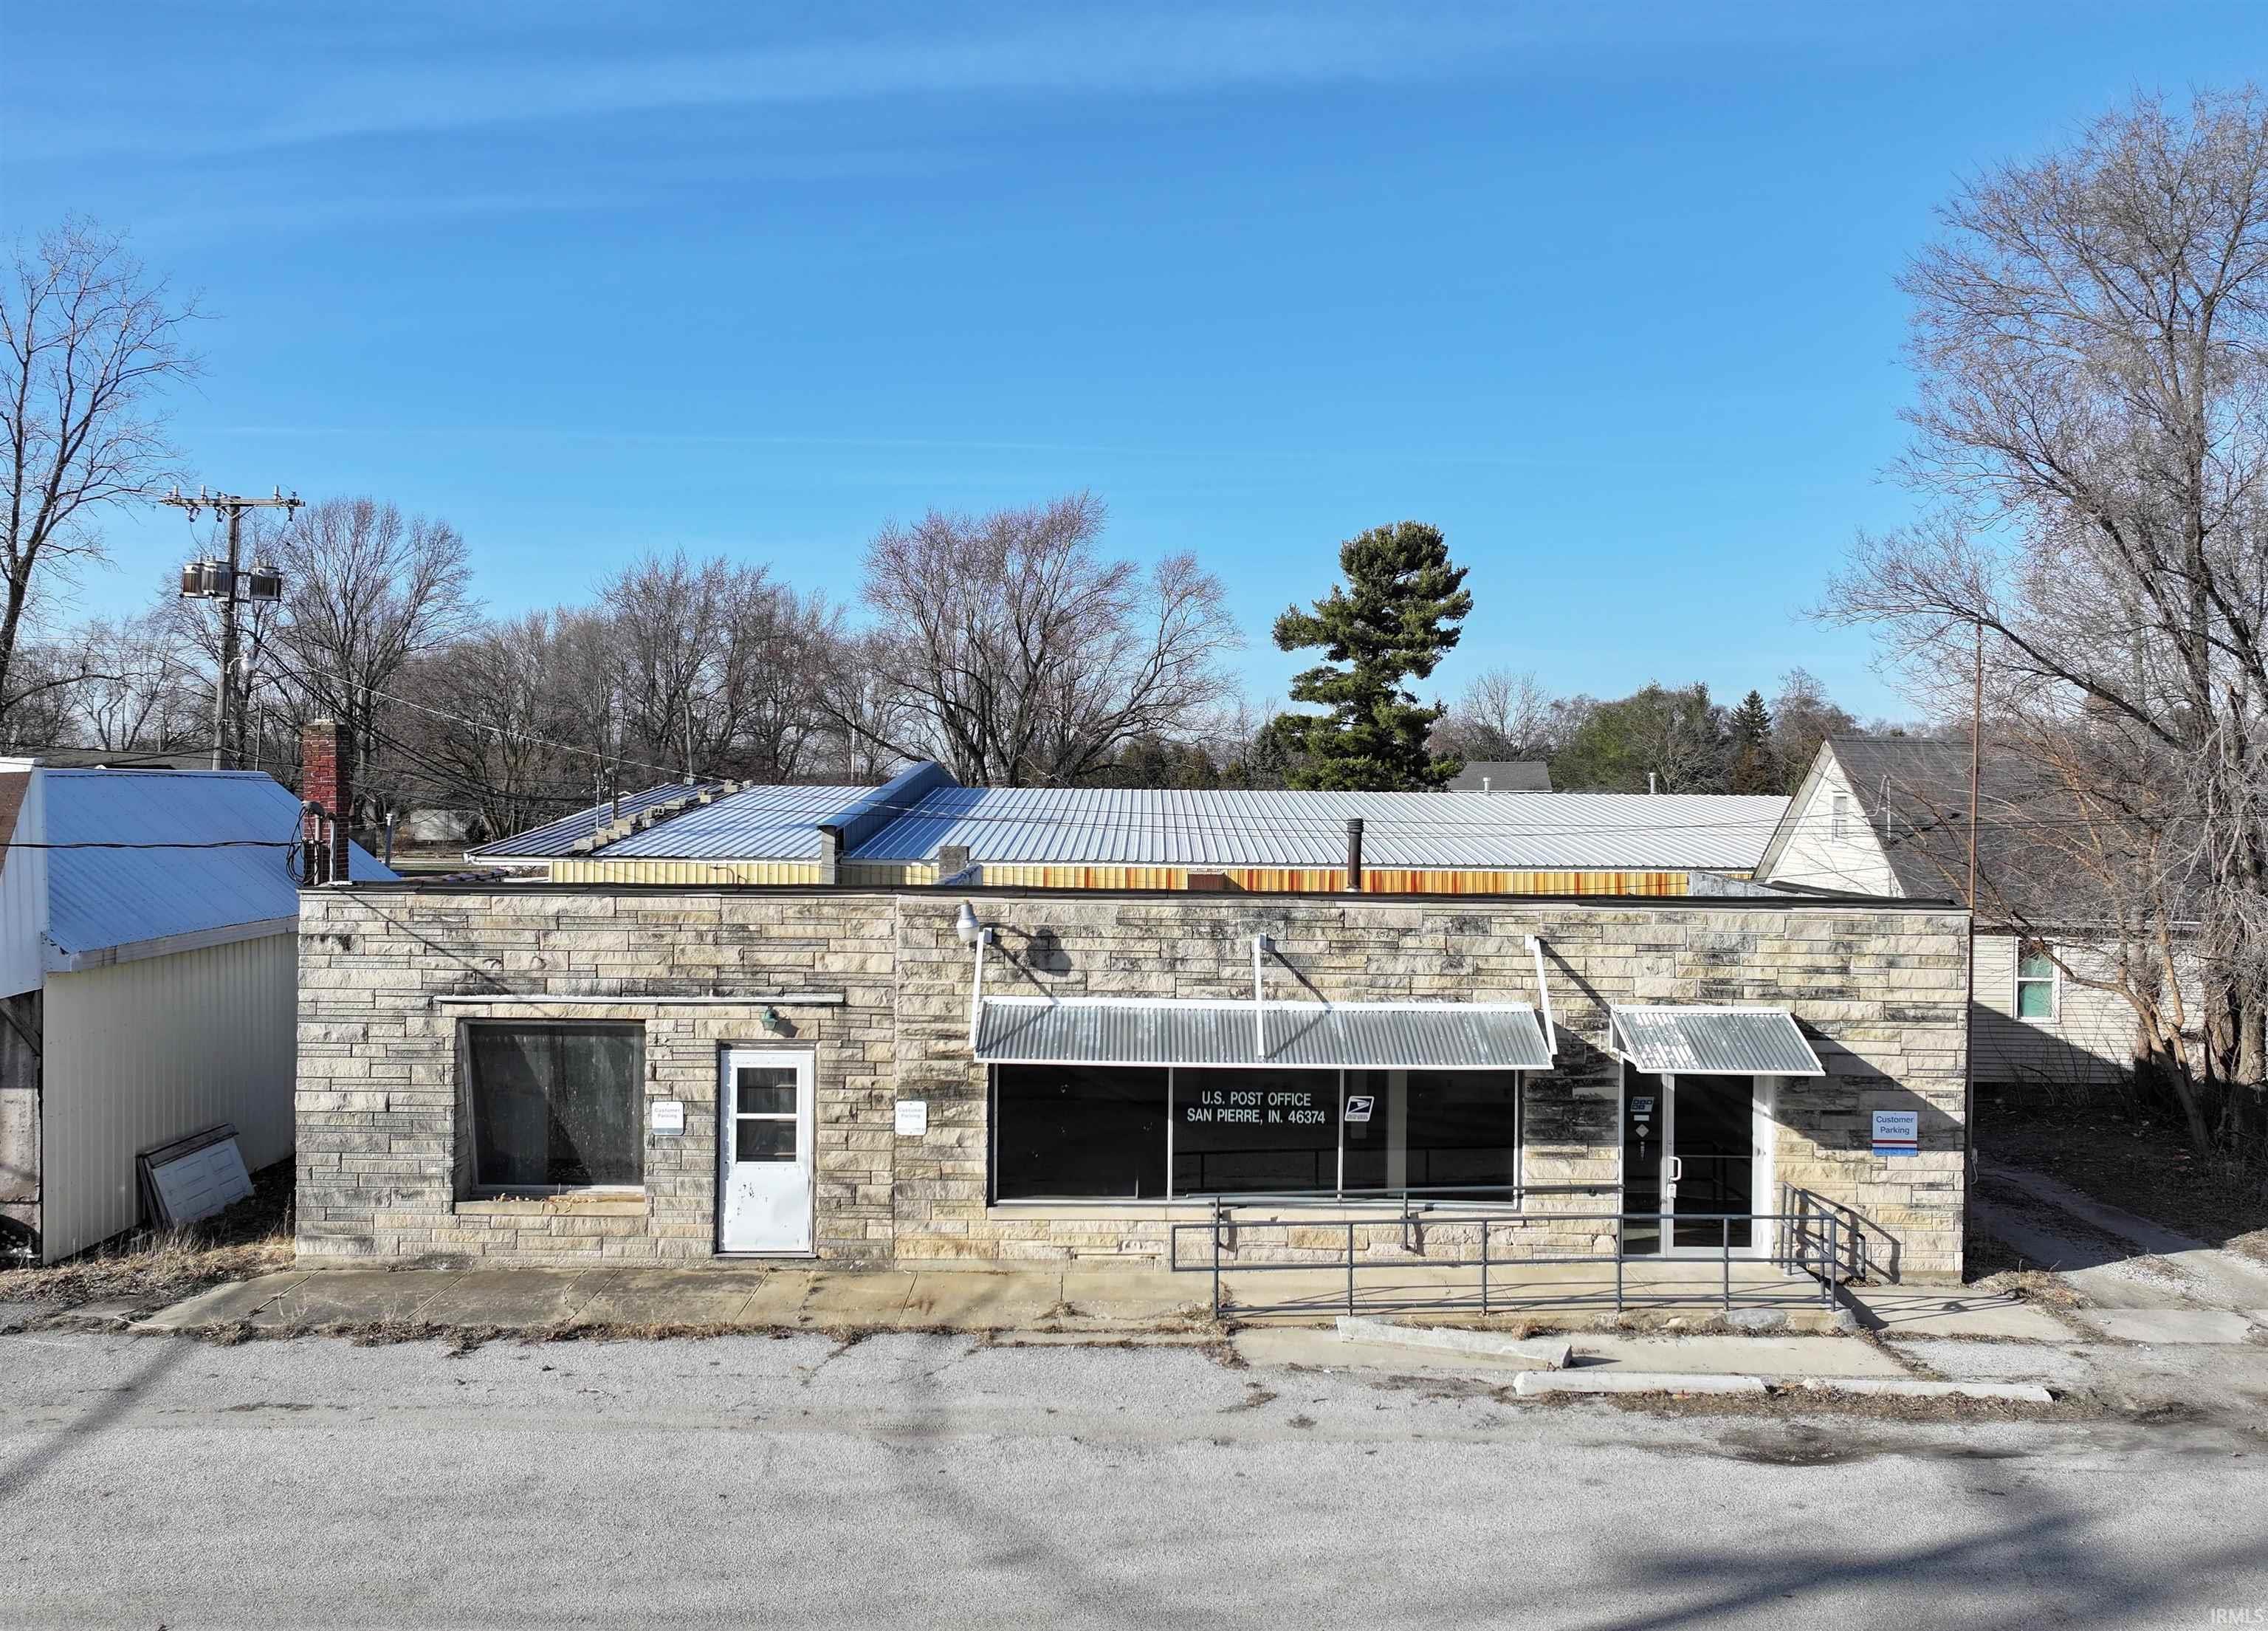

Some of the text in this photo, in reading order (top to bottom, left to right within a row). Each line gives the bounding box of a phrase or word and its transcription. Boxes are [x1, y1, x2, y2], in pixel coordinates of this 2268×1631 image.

[1202, 1091, 1311, 1106] U.S. POST OFFICE
[1186, 1108, 1326, 1125] SAN PIERRE, IN. 46374
[1880, 1126, 1910, 1135] Parking
